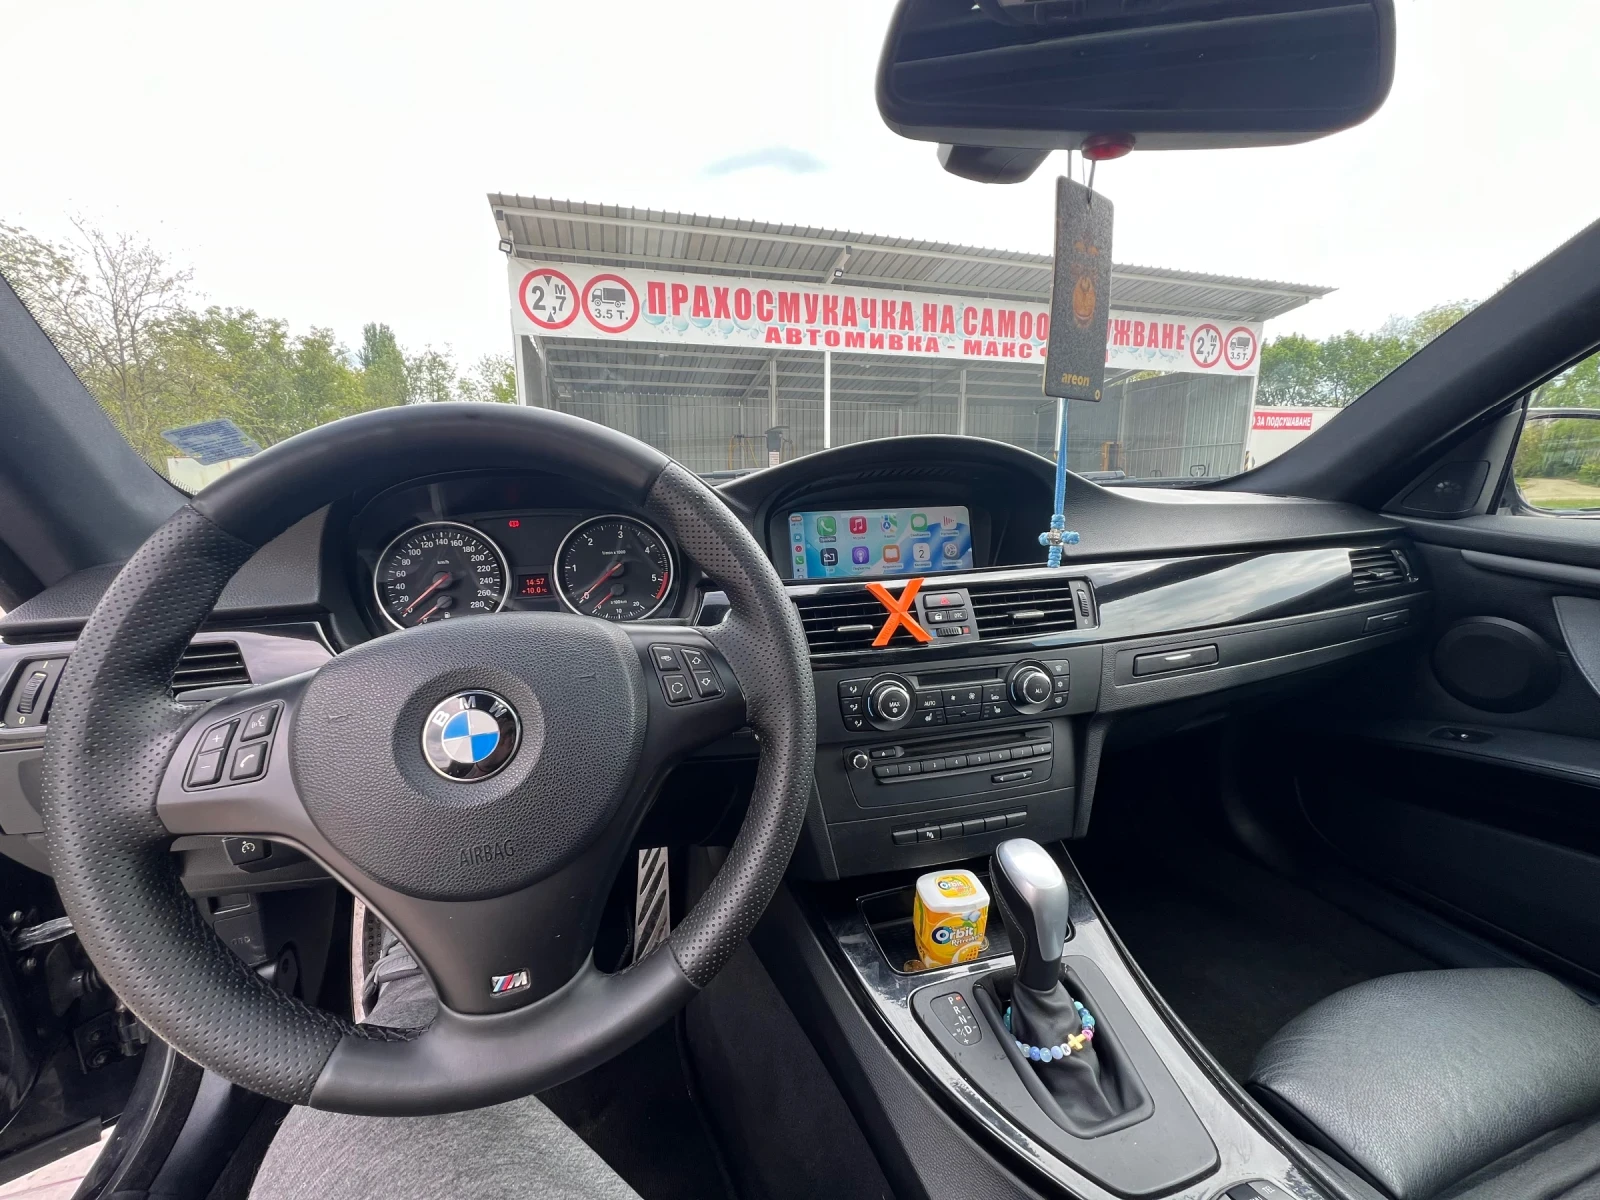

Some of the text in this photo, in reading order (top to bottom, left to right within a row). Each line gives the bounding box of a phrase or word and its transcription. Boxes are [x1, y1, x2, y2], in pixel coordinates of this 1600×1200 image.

[647, 281, 914, 331] ПРАХОСМУКАЧКА
[922, 303, 955, 334] НА
[594, 308, 614, 320] 3.5
[765, 326, 940, 353] АВТОМИВКА
[963, 339, 1033, 359] МАКС
[1230, 351, 1242, 361] 3.5
[1061, 372, 1090, 387] areon
[1256, 416, 1265, 426] ЗА
[1266, 416, 1311, 428] ПОДСУШАВАНЕ
[618, 530, 624, 539] 3
[435, 538, 448, 546] 140
[587, 538, 593, 546] 2
[408, 548, 421, 556] 100
[644, 546, 650, 554] 4
[918, 549, 925, 559] 2
[470, 554, 485, 562] 200
[572, 564, 577, 572] 1
[479, 577, 493, 585] 240
[526, 578, 545, 586] 14:57
[651, 574, 657, 582] 5
[477, 589, 491, 597] 260
[470, 601, 484, 609] 280
[459, 839, 514, 868] AIRBAG
[935, 926, 974, 944] Orbit
[947, 996, 955, 1005] P
[953, 1005, 962, 1015] R
[958, 1014, 968, 1025] N
[964, 1025, 973, 1035] D
